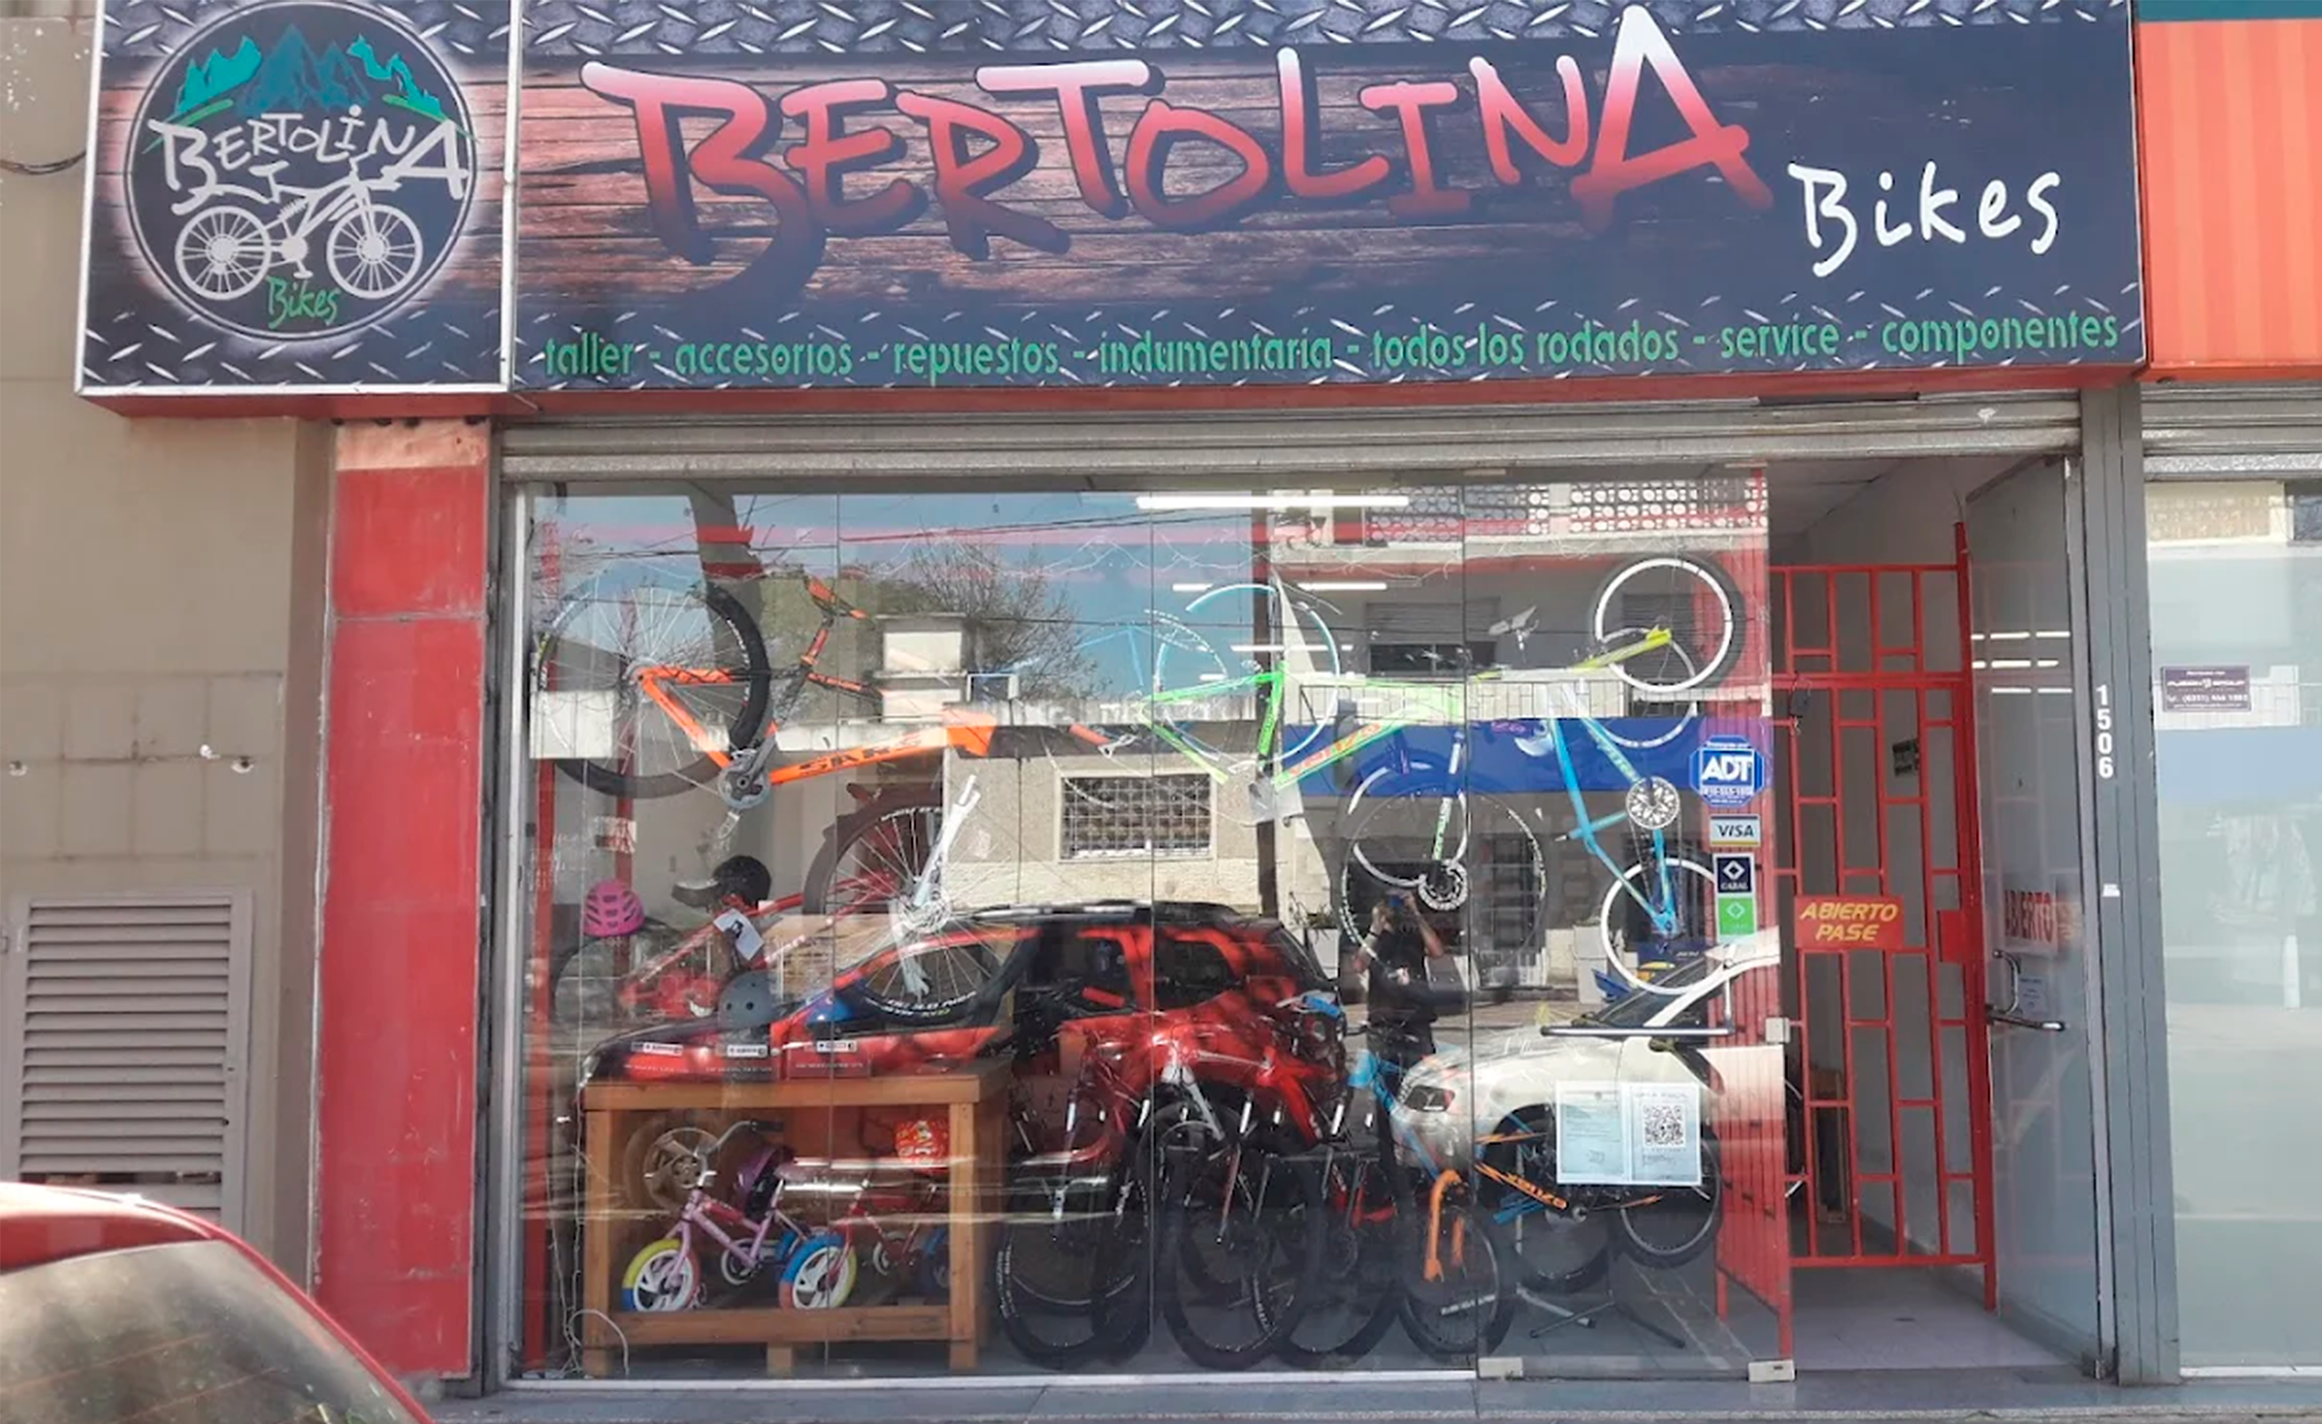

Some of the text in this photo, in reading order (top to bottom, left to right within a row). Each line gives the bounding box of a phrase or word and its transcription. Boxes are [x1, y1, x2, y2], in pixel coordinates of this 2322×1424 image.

[147, 104, 469, 216] BERTOLINA
[580, 4, 1774, 292] BERTOLINA
[1787, 160, 2062, 279] Bikes
[266, 275, 341, 330] Bikes
[545, 332, 634, 376] taller
[674, 332, 854, 377] accesorios
[894, 337, 1058, 387] repuestos
[1099, 328, 1333, 373] indumentaria
[1373, 324, 1465, 369] todos
[1478, 322, 1524, 366] los
[1537, 318, 1679, 364] rodados
[1720, 314, 1840, 359] service
[1881, 311, 2118, 366] componentes
[2096, 684, 2114, 779] 1506
[1701, 755, 1753, 782] ADT
[1715, 824, 1755, 838] VISA
[1800, 901, 1898, 922] ABIERTO
[1815, 923, 1880, 942] PASE
